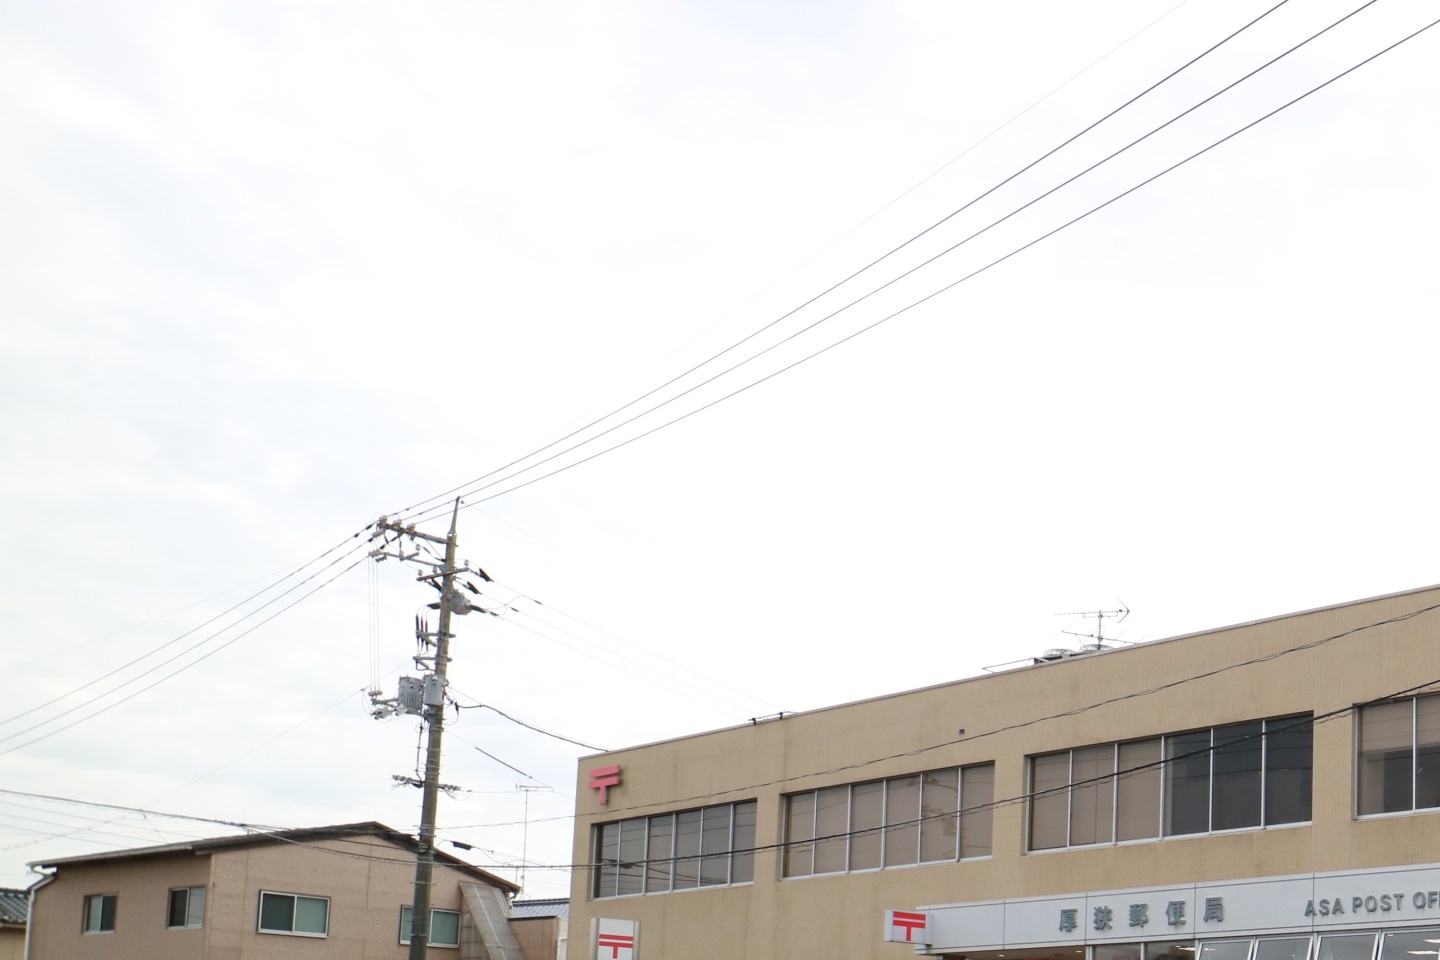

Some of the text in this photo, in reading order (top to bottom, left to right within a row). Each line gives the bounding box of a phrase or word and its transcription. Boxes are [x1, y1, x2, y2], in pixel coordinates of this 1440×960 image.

[1058, 897, 1225, 932] 厚狭郵便局
[1304, 897, 1345, 917] ASA
[1352, 893, 1404, 914] POST
